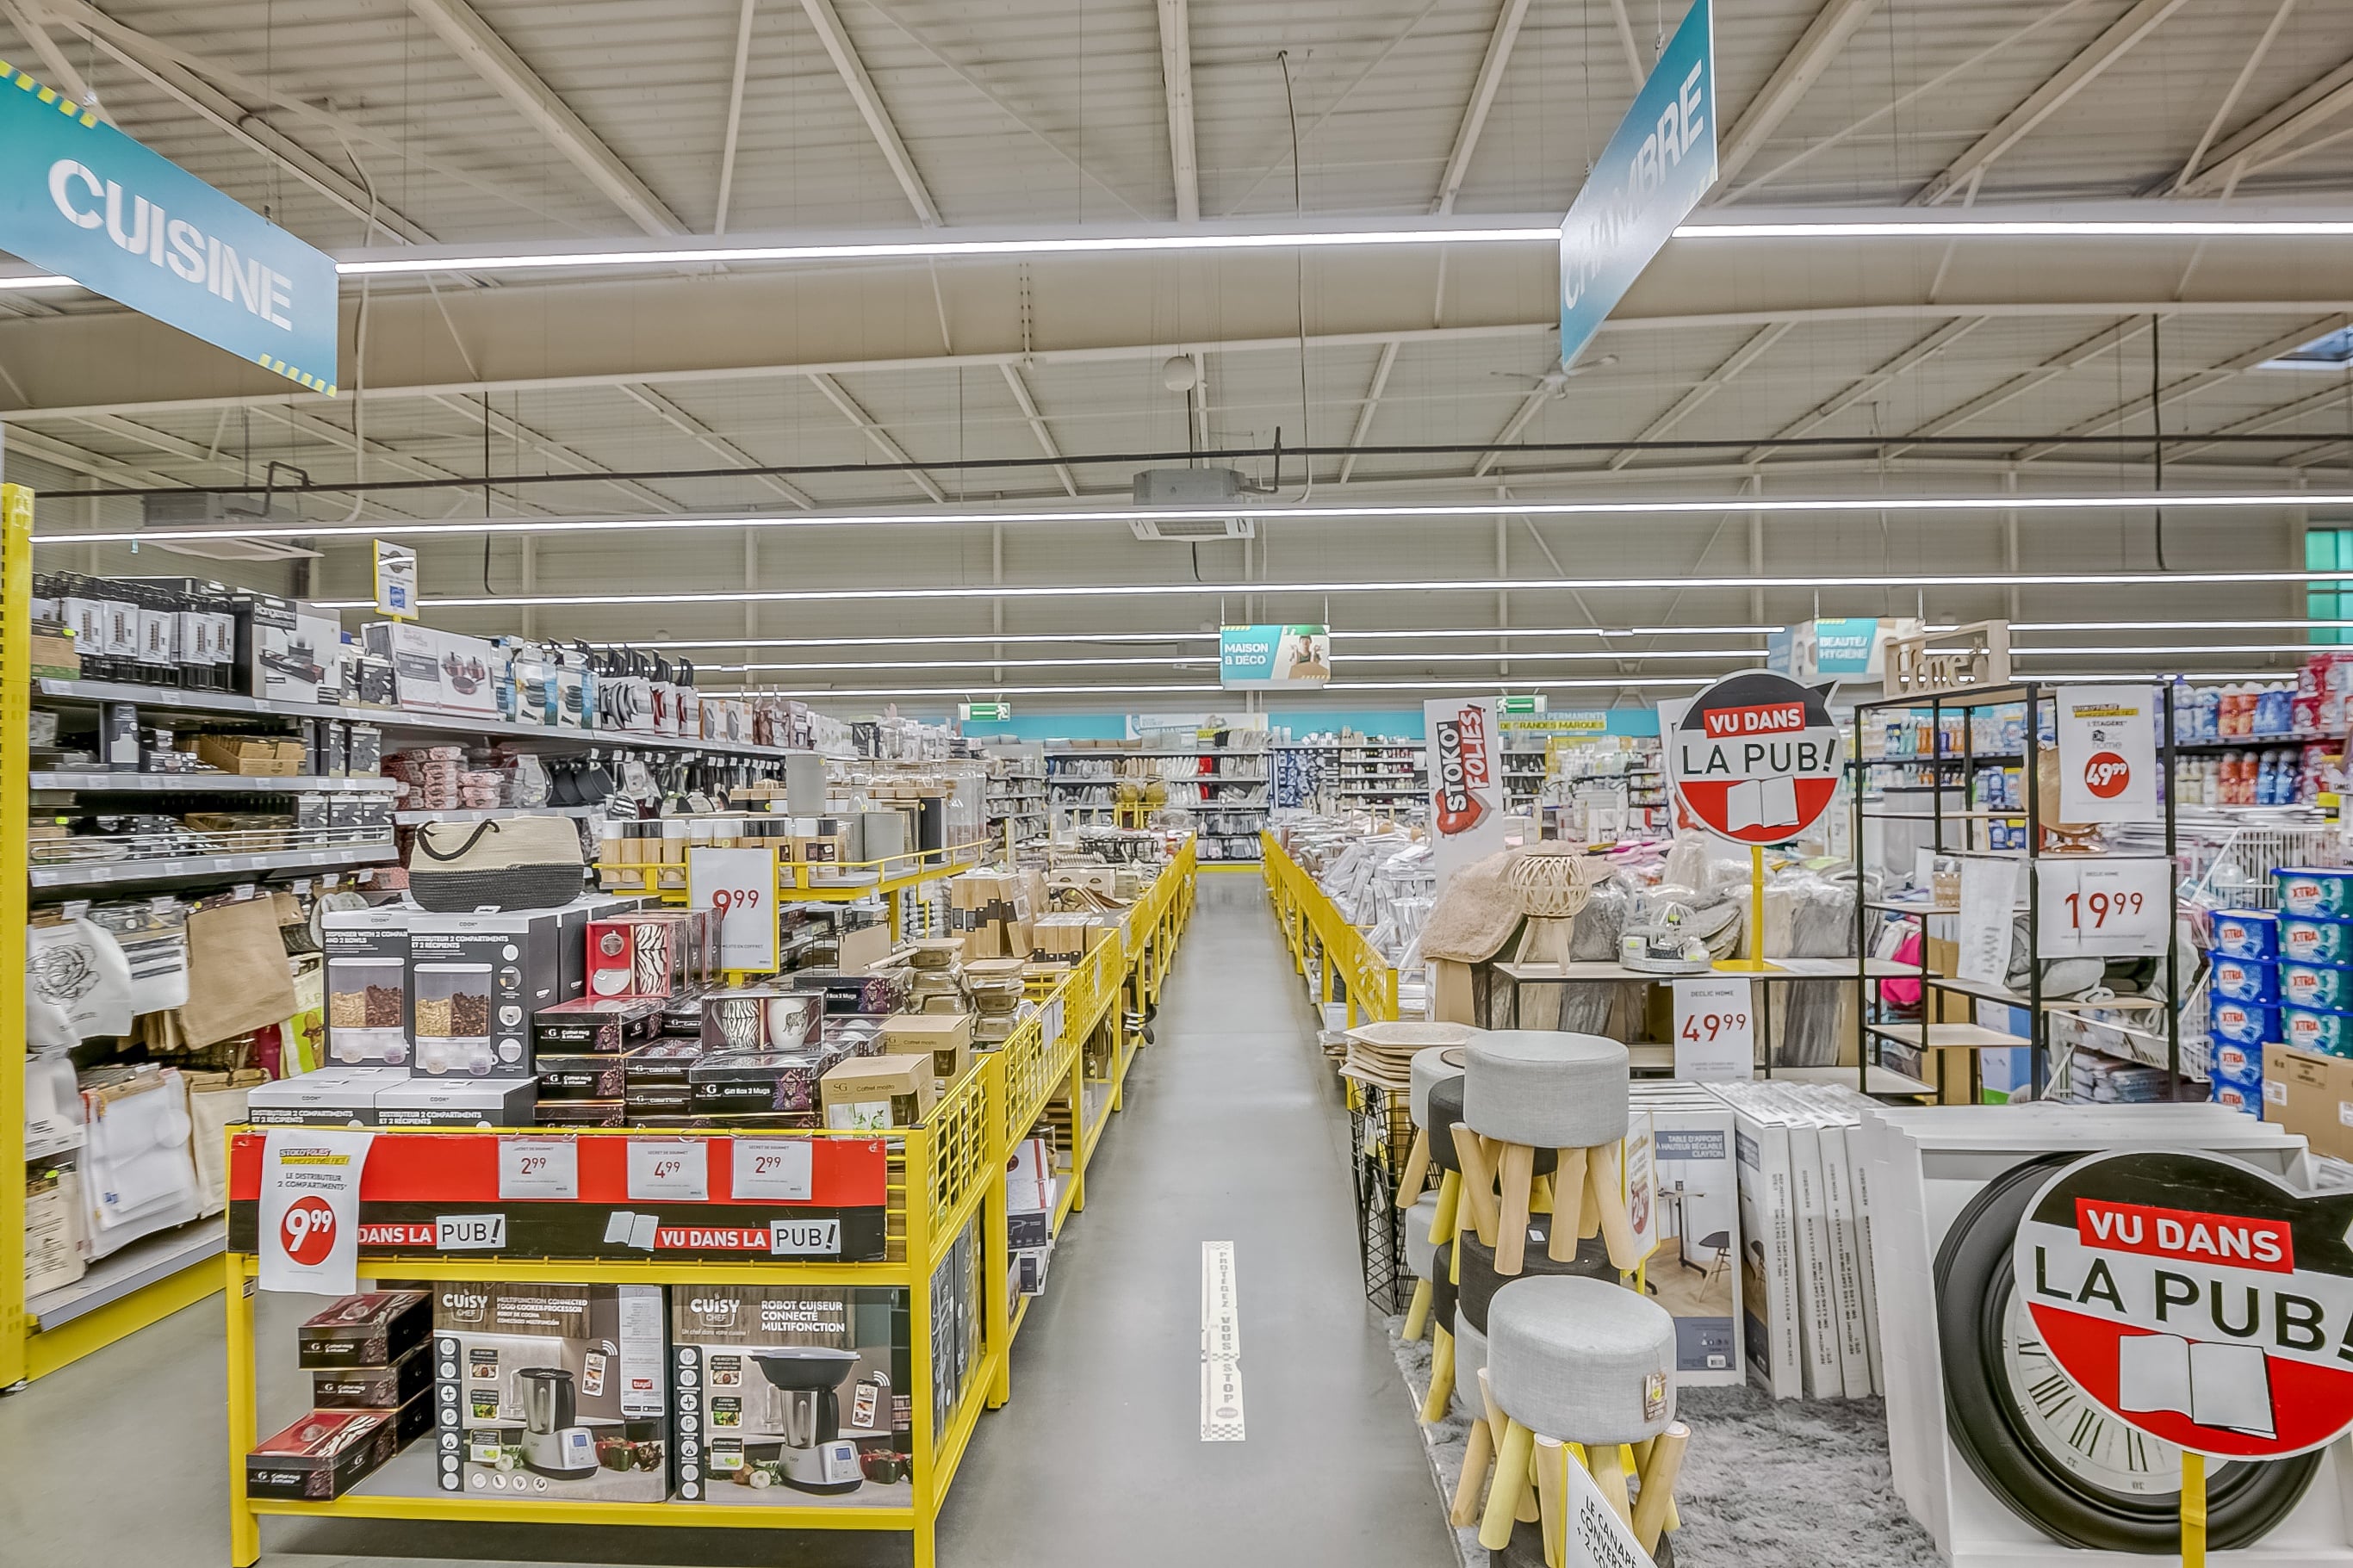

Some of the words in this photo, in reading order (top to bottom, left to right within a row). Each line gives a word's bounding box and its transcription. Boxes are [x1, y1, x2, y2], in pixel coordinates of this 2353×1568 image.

[48, 158, 293, 332] CUISINE
[1224, 642, 1269, 654] MAISON
[1225, 655, 1232, 665] &
[1235, 654, 1266, 665] DÉCO
[1709, 714, 1739, 734] VU
[1744, 709, 1801, 732] DANS
[1682, 745, 1730, 775] LA
[2292, 885, 2320, 898] XTRA
[2293, 930, 2318, 943] XTRA
[2293, 976, 2318, 987] XTRA
[2294, 1020, 2319, 1032] XTRA
[753, 1088, 771, 1096] Mugs
[295, 1172, 342, 1181] DISTRIBUTEUR
[358, 1226, 405, 1243] DANS
[409, 1226, 432, 1243] LA
[661, 1230, 686, 1247] VU
[690, 1230, 738, 1248] DANS
[742, 1230, 767, 1248] LA
[2086, 1209, 2144, 1245] VU
[2156, 1218, 2282, 1262] DANS
[2035, 1245, 2128, 1314] LA
[761, 1300, 797, 1311] ROBOT
[798, 1301, 843, 1311] CUISEUR
[705, 1313, 727, 1322] CHEF
[761, 1310, 818, 1321] CONNECTÉ
[761, 1322, 846, 1333] MULTIFONCTION
[1586, 1495, 1595, 1517] LE
